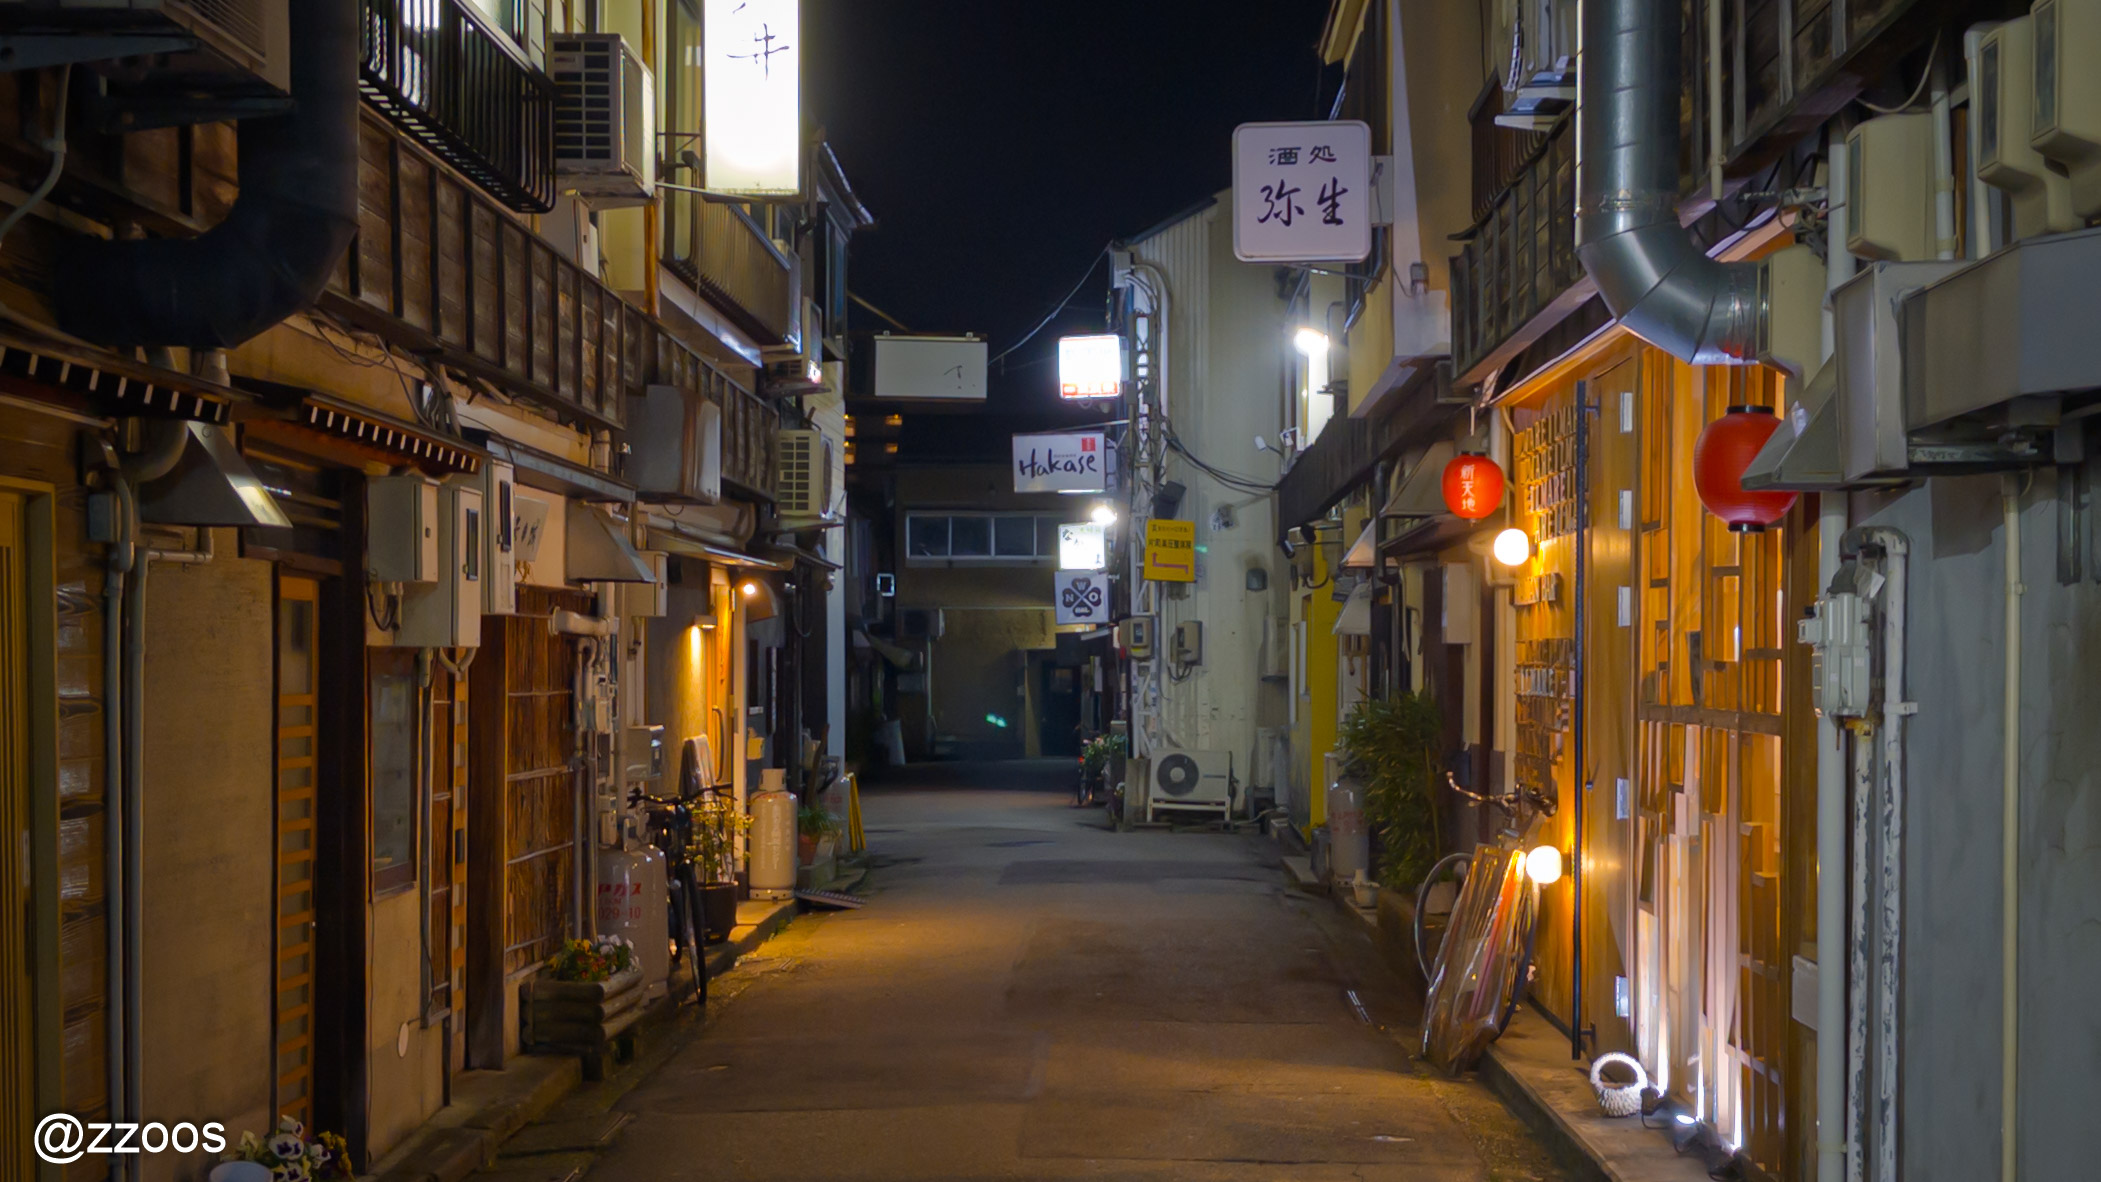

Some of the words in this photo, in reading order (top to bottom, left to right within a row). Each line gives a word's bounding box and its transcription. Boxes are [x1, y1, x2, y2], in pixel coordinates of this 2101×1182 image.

[1268, 145, 1337, 165] 酒処
[1257, 176, 1349, 227] 弥生
[1019, 448, 1098, 479] Hakase
[1460, 464, 1476, 512] 新天地
[1076, 581, 1087, 591] W
[1065, 594, 1074, 603] N
[1088, 592, 1099, 601] O
